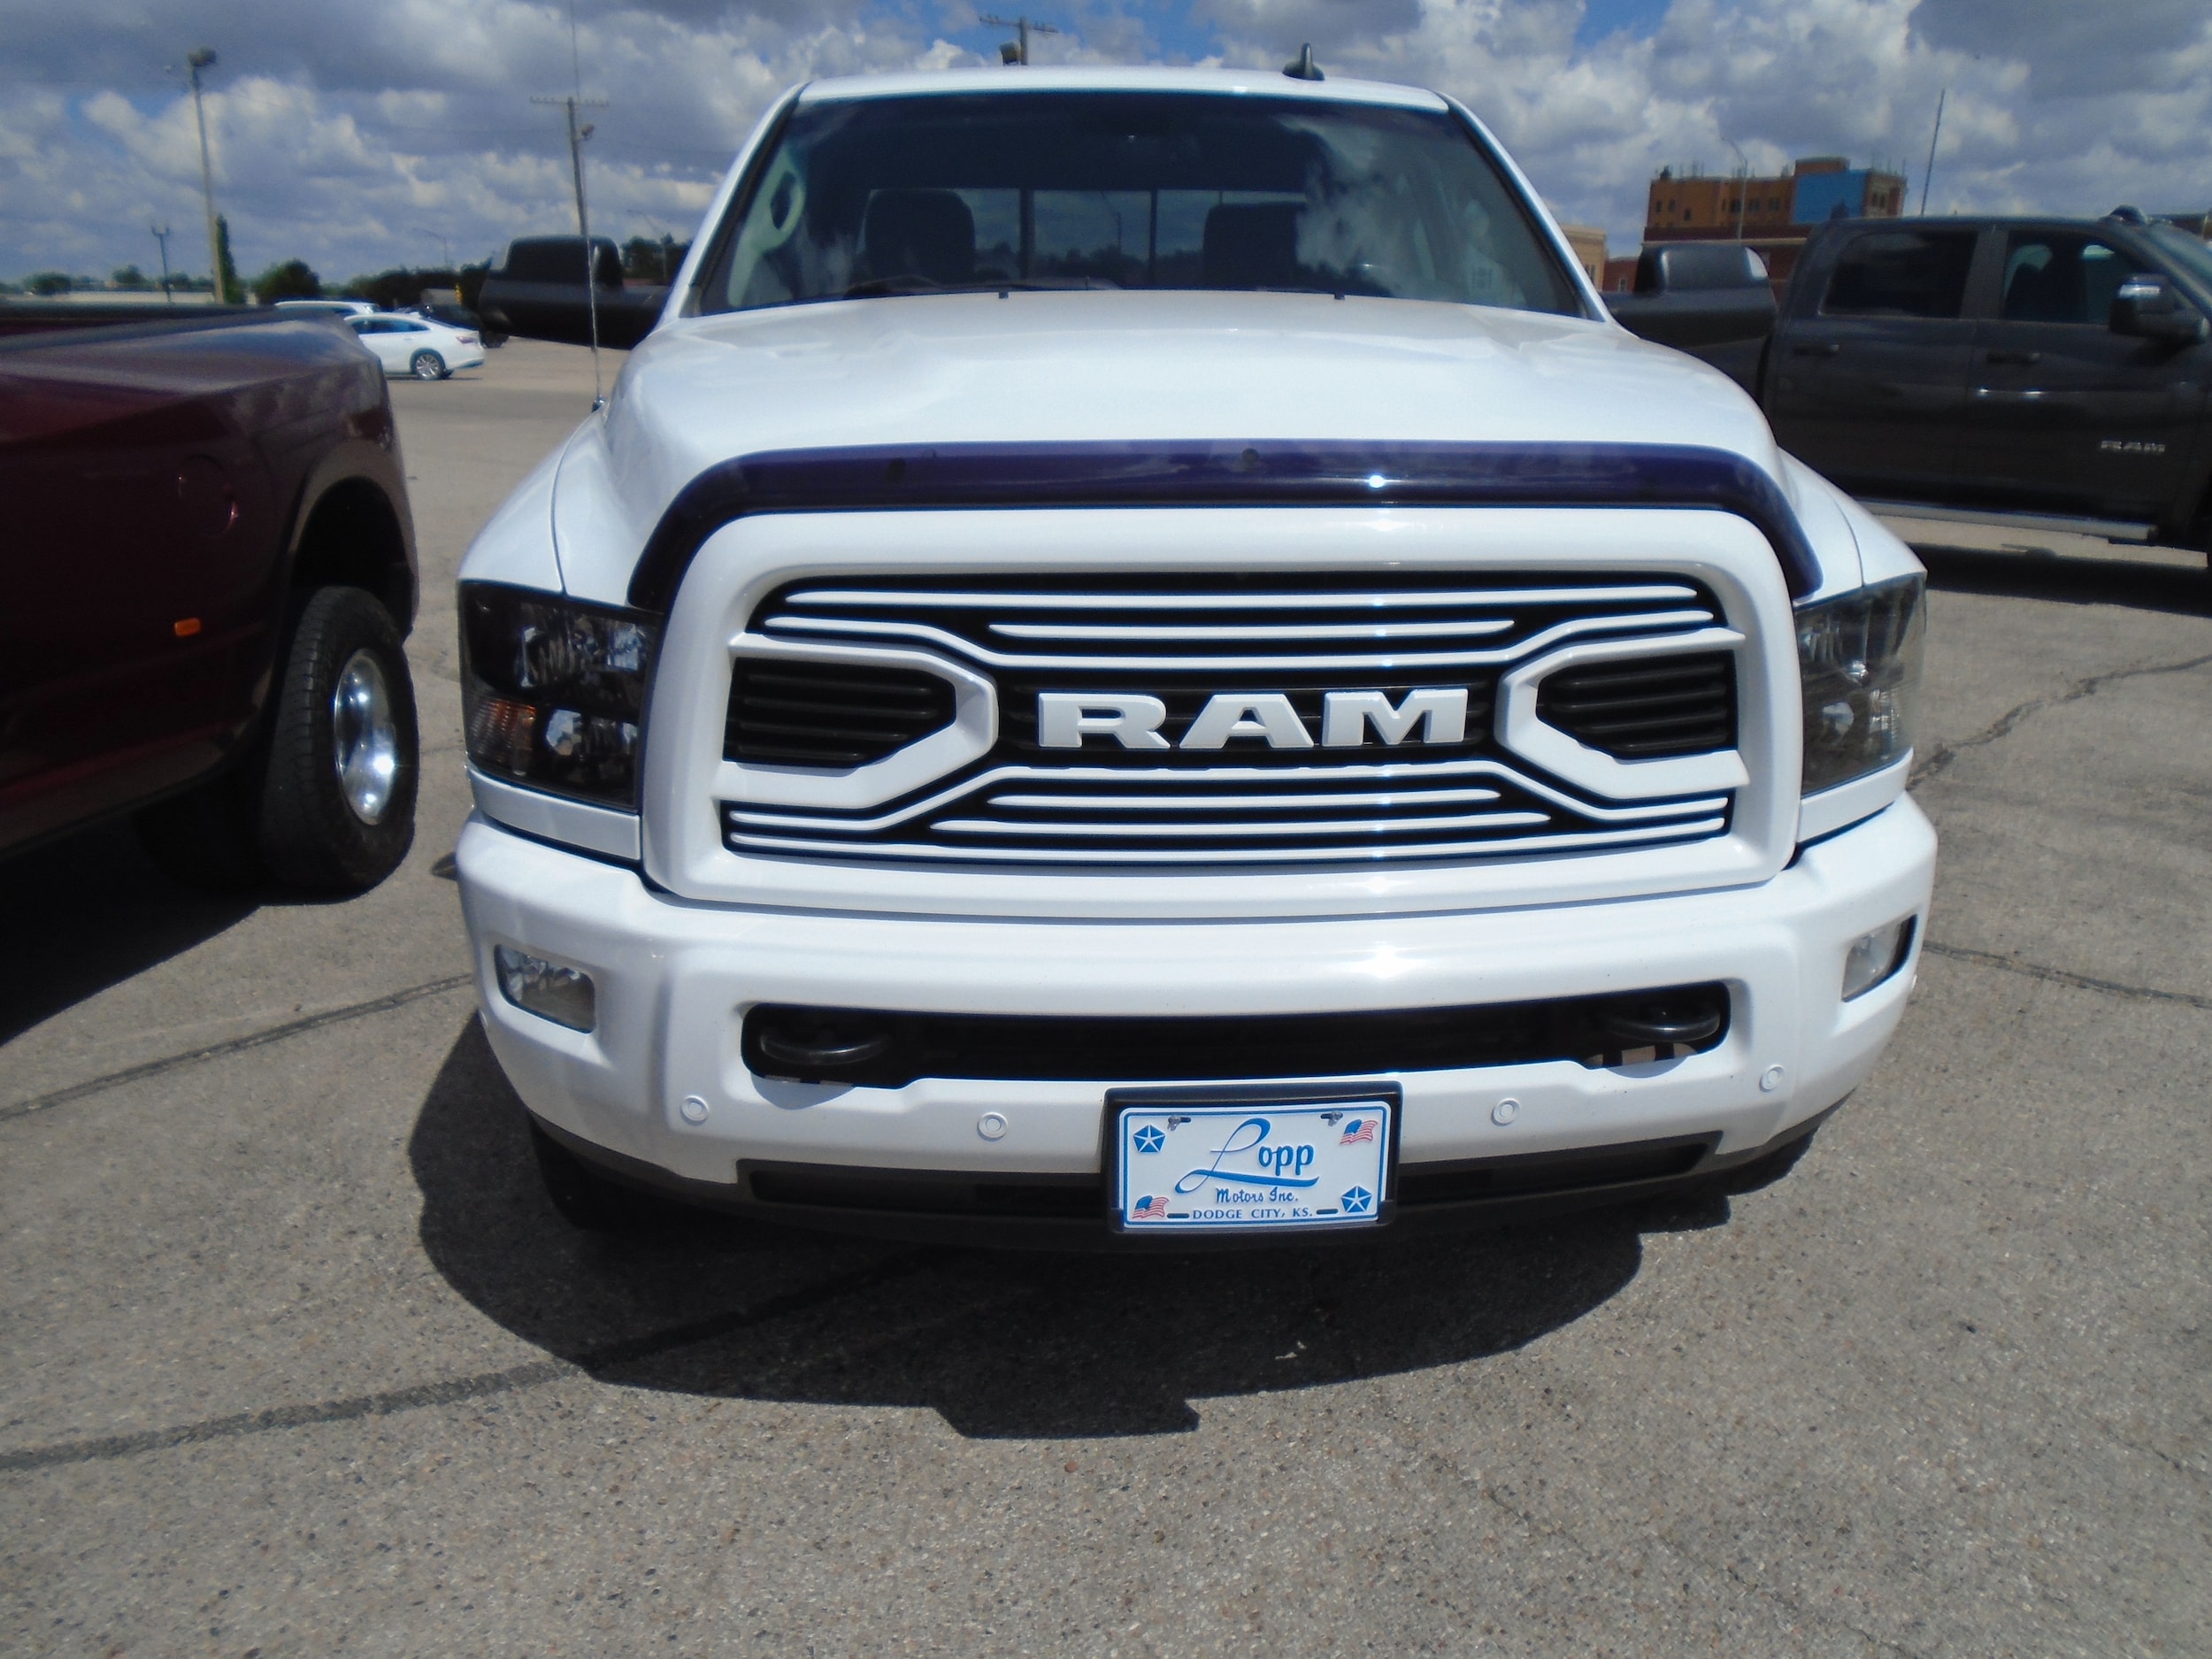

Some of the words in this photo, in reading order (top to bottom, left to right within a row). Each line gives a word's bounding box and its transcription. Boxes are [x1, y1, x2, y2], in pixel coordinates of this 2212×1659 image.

[1038, 688, 1468, 749] RAM
[1174, 1118, 1319, 1194] Lopp
[1193, 1209, 1242, 1220] DODGE
[1251, 1208, 1286, 1218] CITY,
[1292, 1207, 1313, 1217] KS.
[1215, 1187, 1263, 1203] Motors
[1269, 1187, 1299, 1202] Inc.
